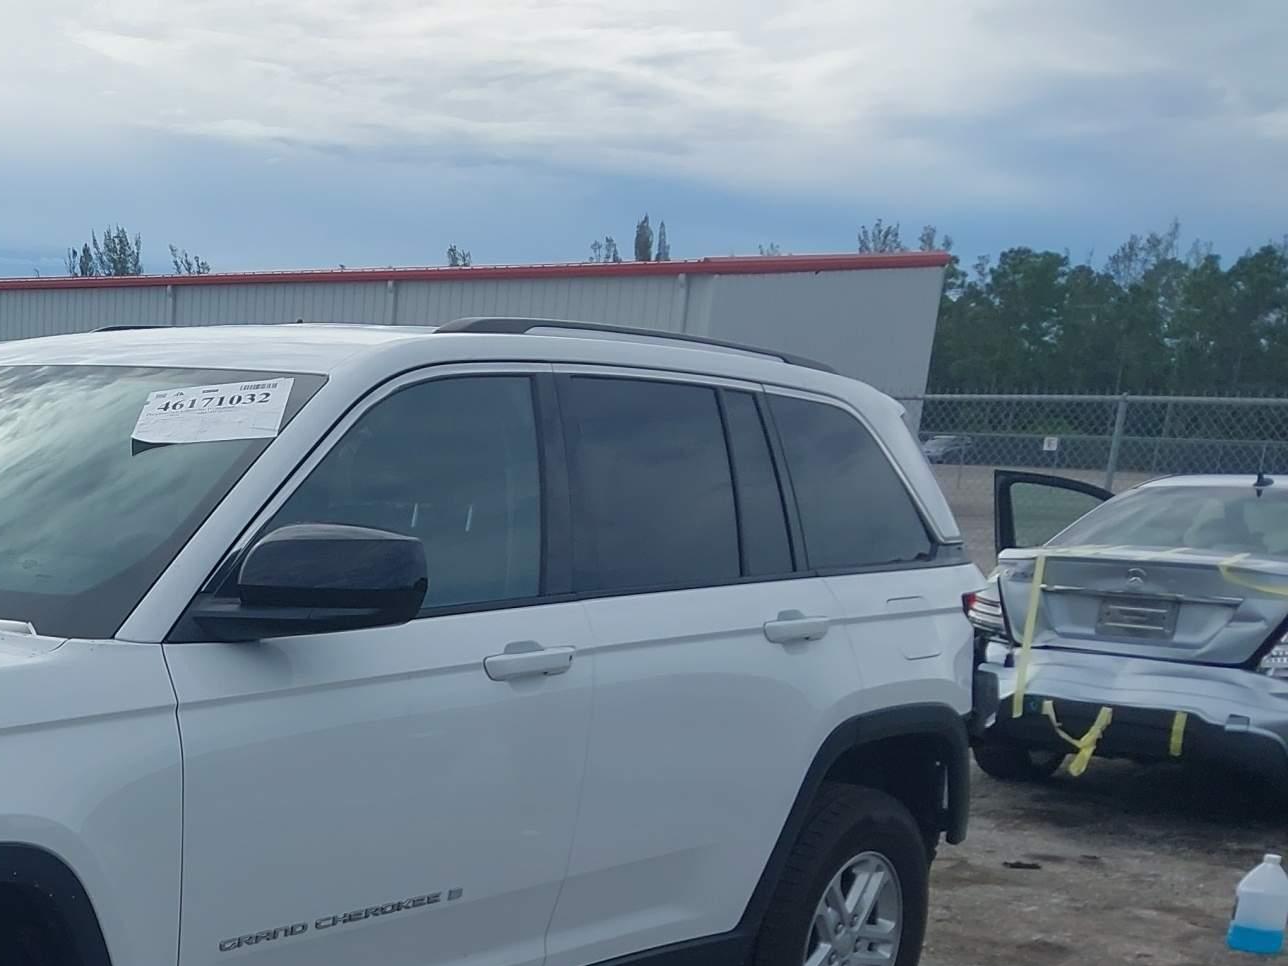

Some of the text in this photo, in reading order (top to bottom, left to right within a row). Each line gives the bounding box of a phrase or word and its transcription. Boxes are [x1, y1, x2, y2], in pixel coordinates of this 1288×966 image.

[157, 391, 271, 413] 46171032
[219, 891, 442, 952] GRAND CHEROKEE
